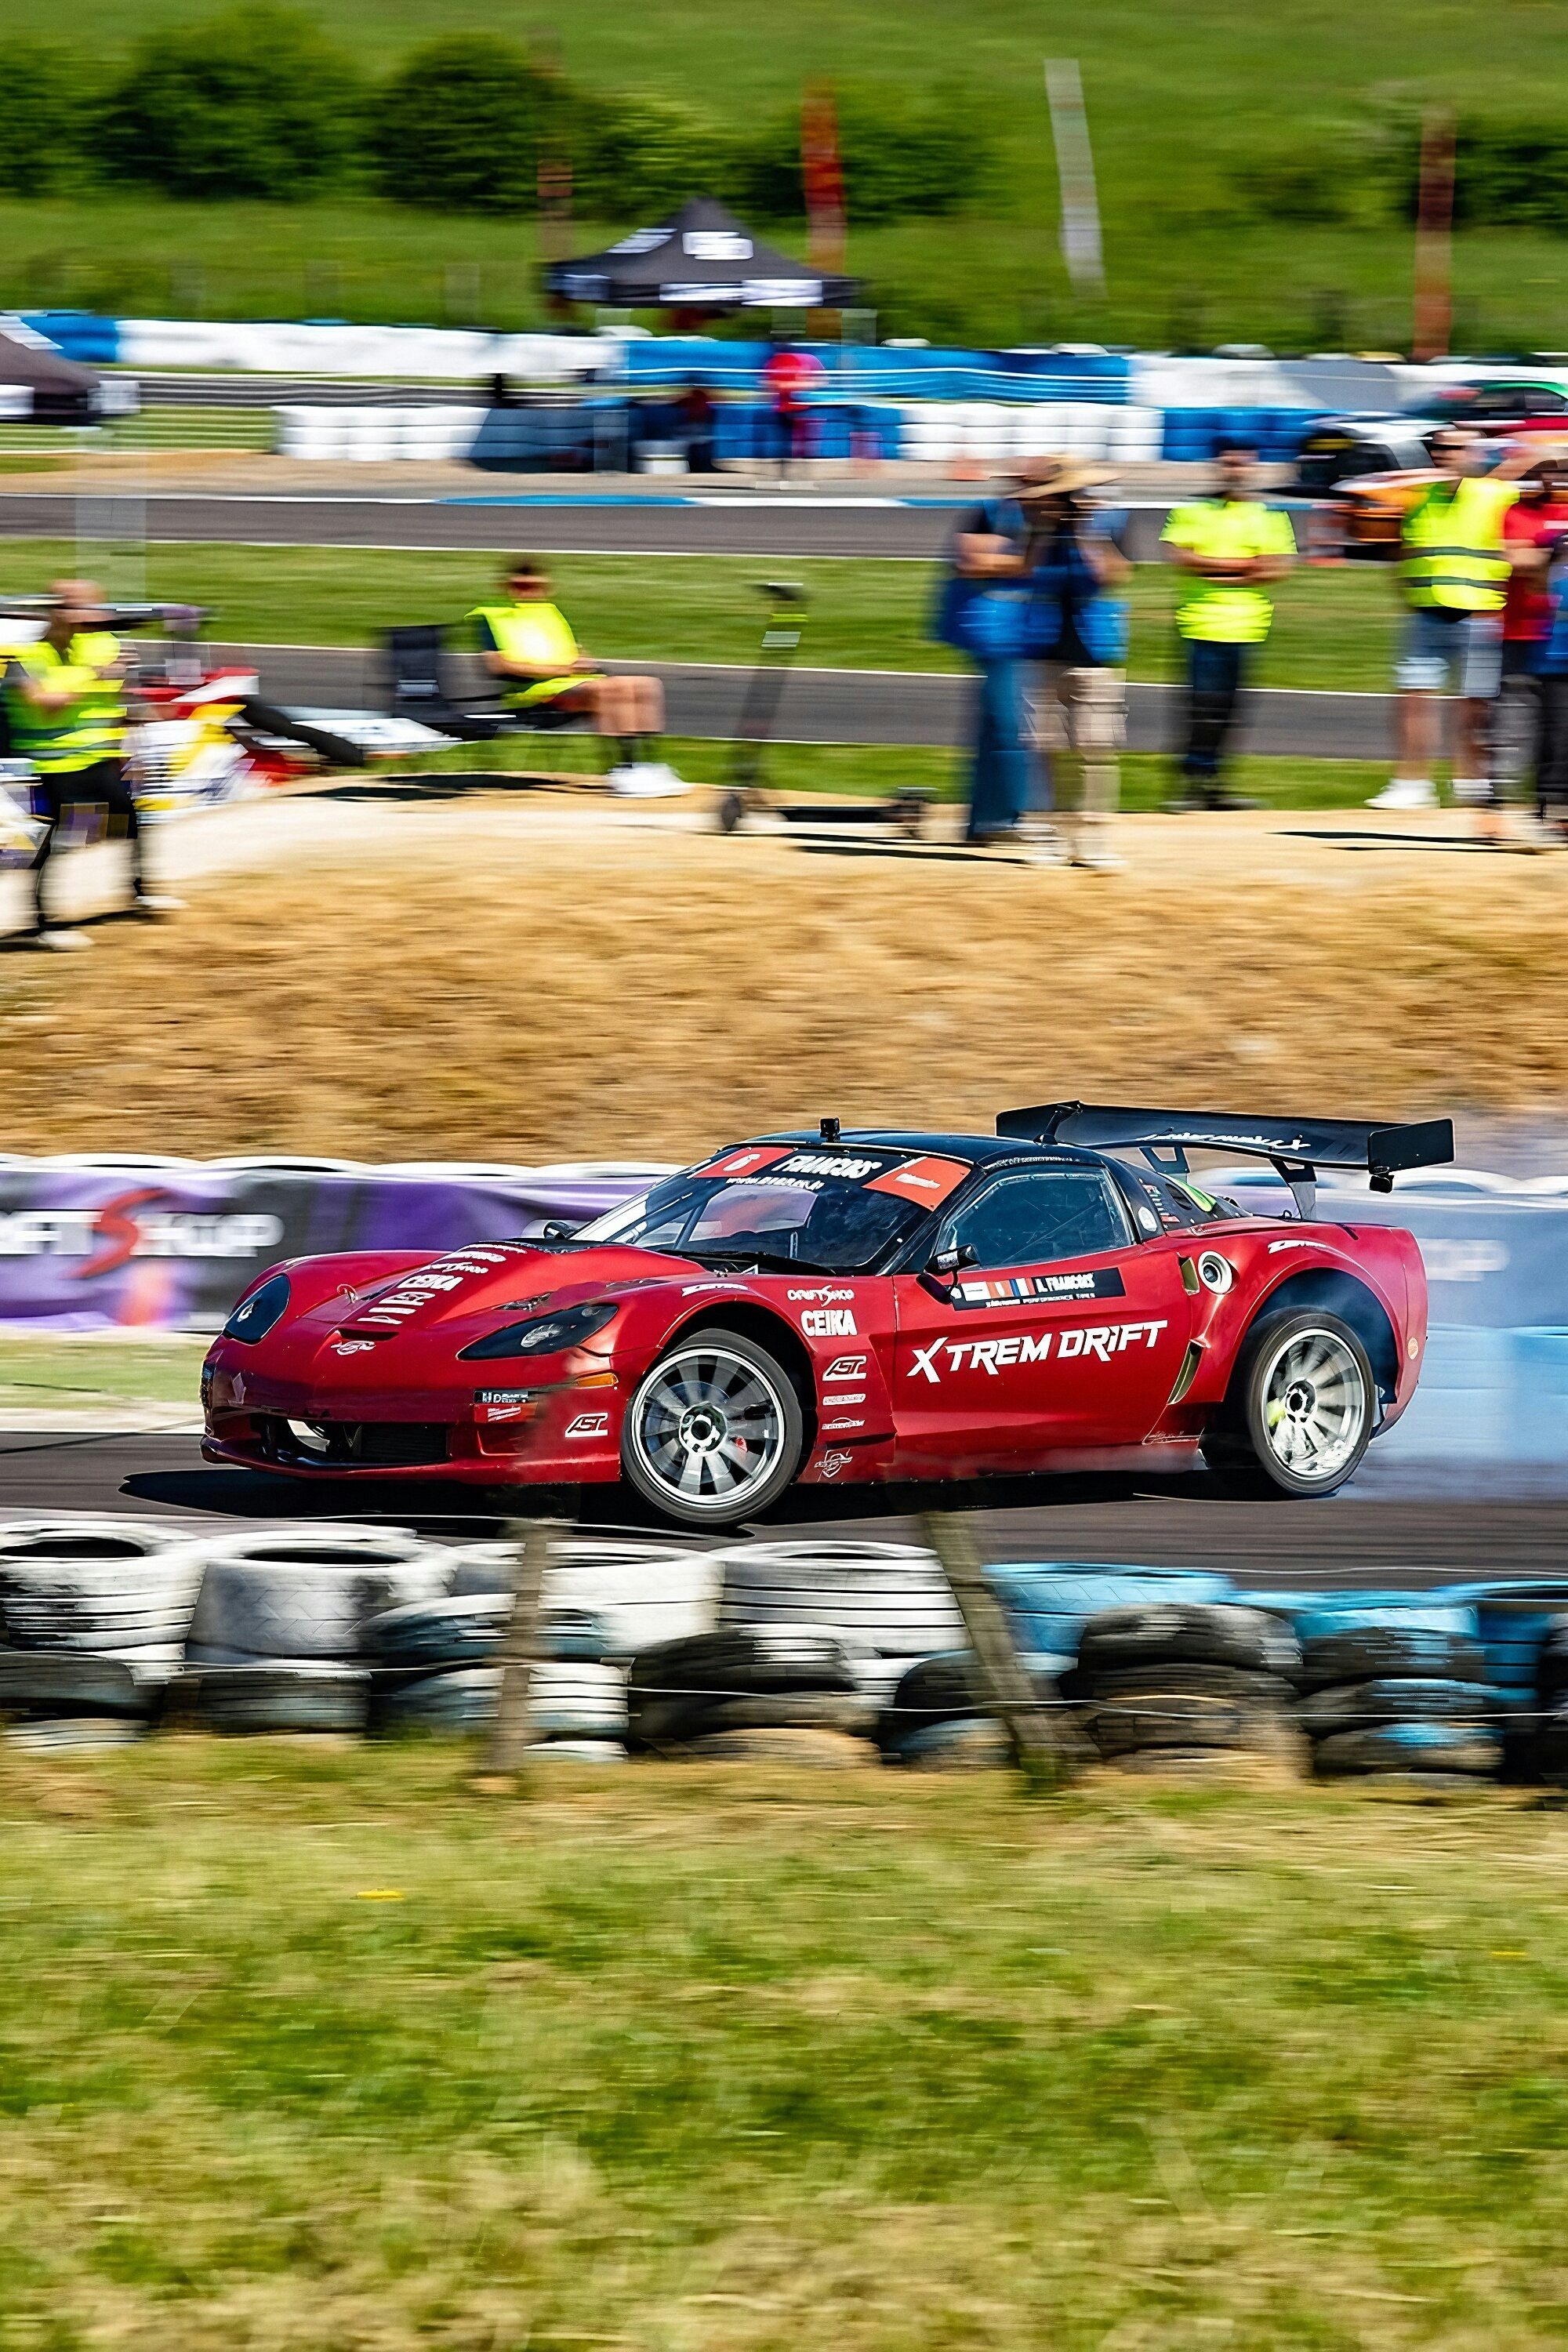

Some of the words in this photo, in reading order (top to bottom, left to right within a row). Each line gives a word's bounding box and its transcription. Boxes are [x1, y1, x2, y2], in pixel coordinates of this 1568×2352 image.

[800, 1308, 858, 1337] CEIKA
[906, 1333, 1053, 1383] XTREM
[1057, 1320, 1167, 1362] DRIFT
